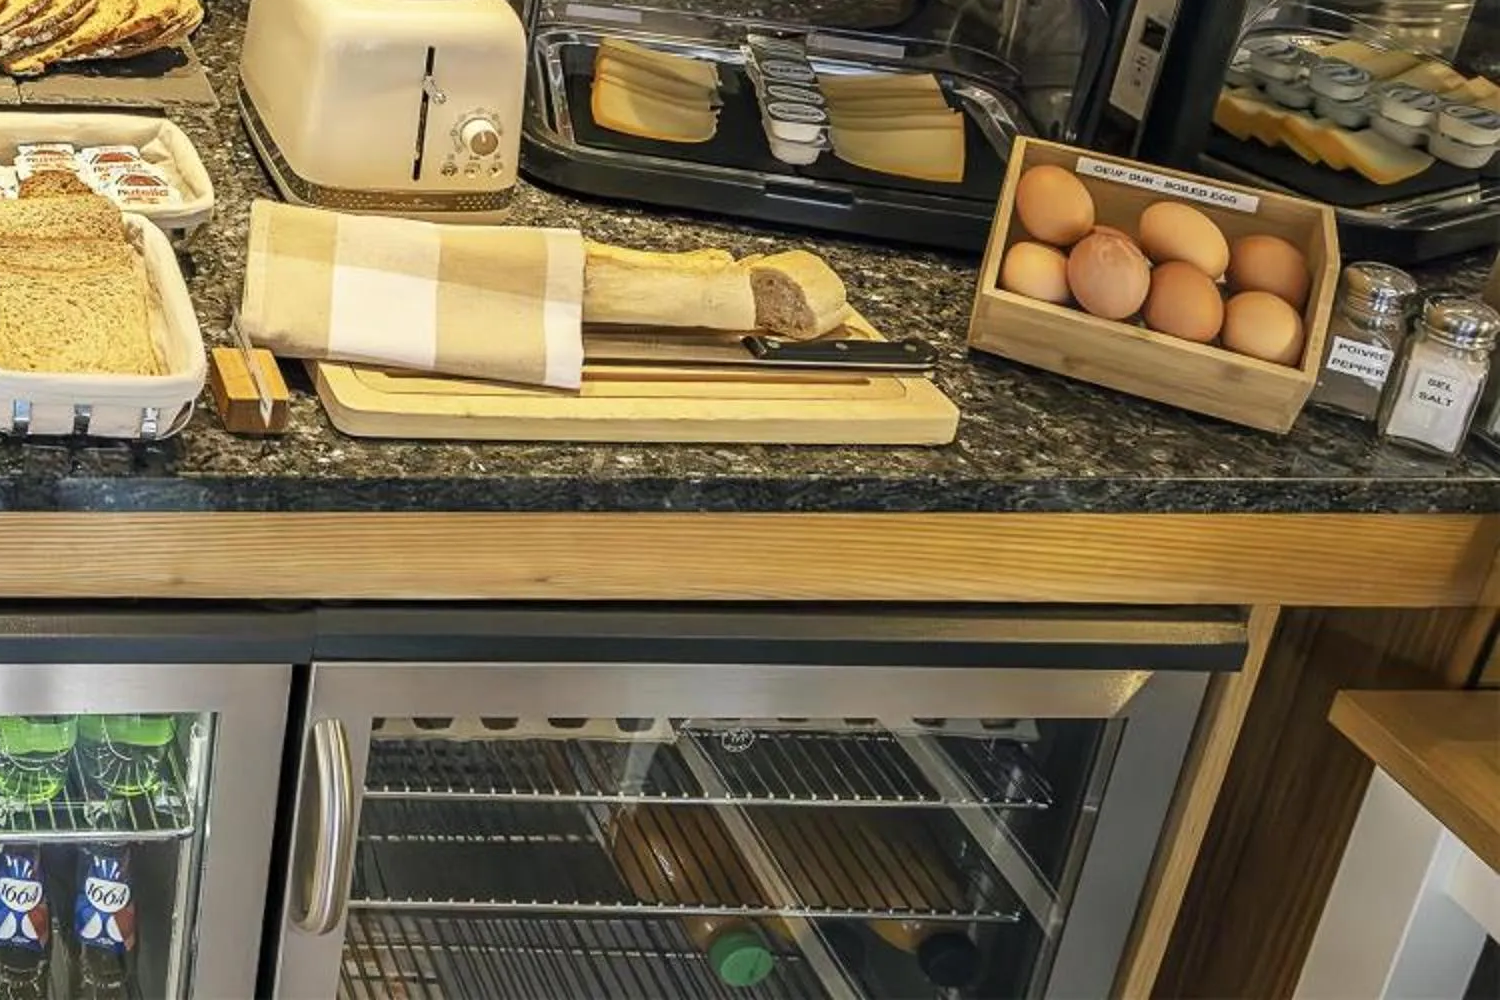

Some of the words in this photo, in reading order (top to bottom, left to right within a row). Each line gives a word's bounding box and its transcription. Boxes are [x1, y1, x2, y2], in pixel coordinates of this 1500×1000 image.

[1339, 343, 1388, 362] POIVRE
[1331, 357, 1385, 378] PEPPER
[1426, 377, 1453, 391] SEL
[1418, 391, 1454, 407] SALT
[1, 883, 40, 904] 1664
[87, 882, 127, 906] 1664
